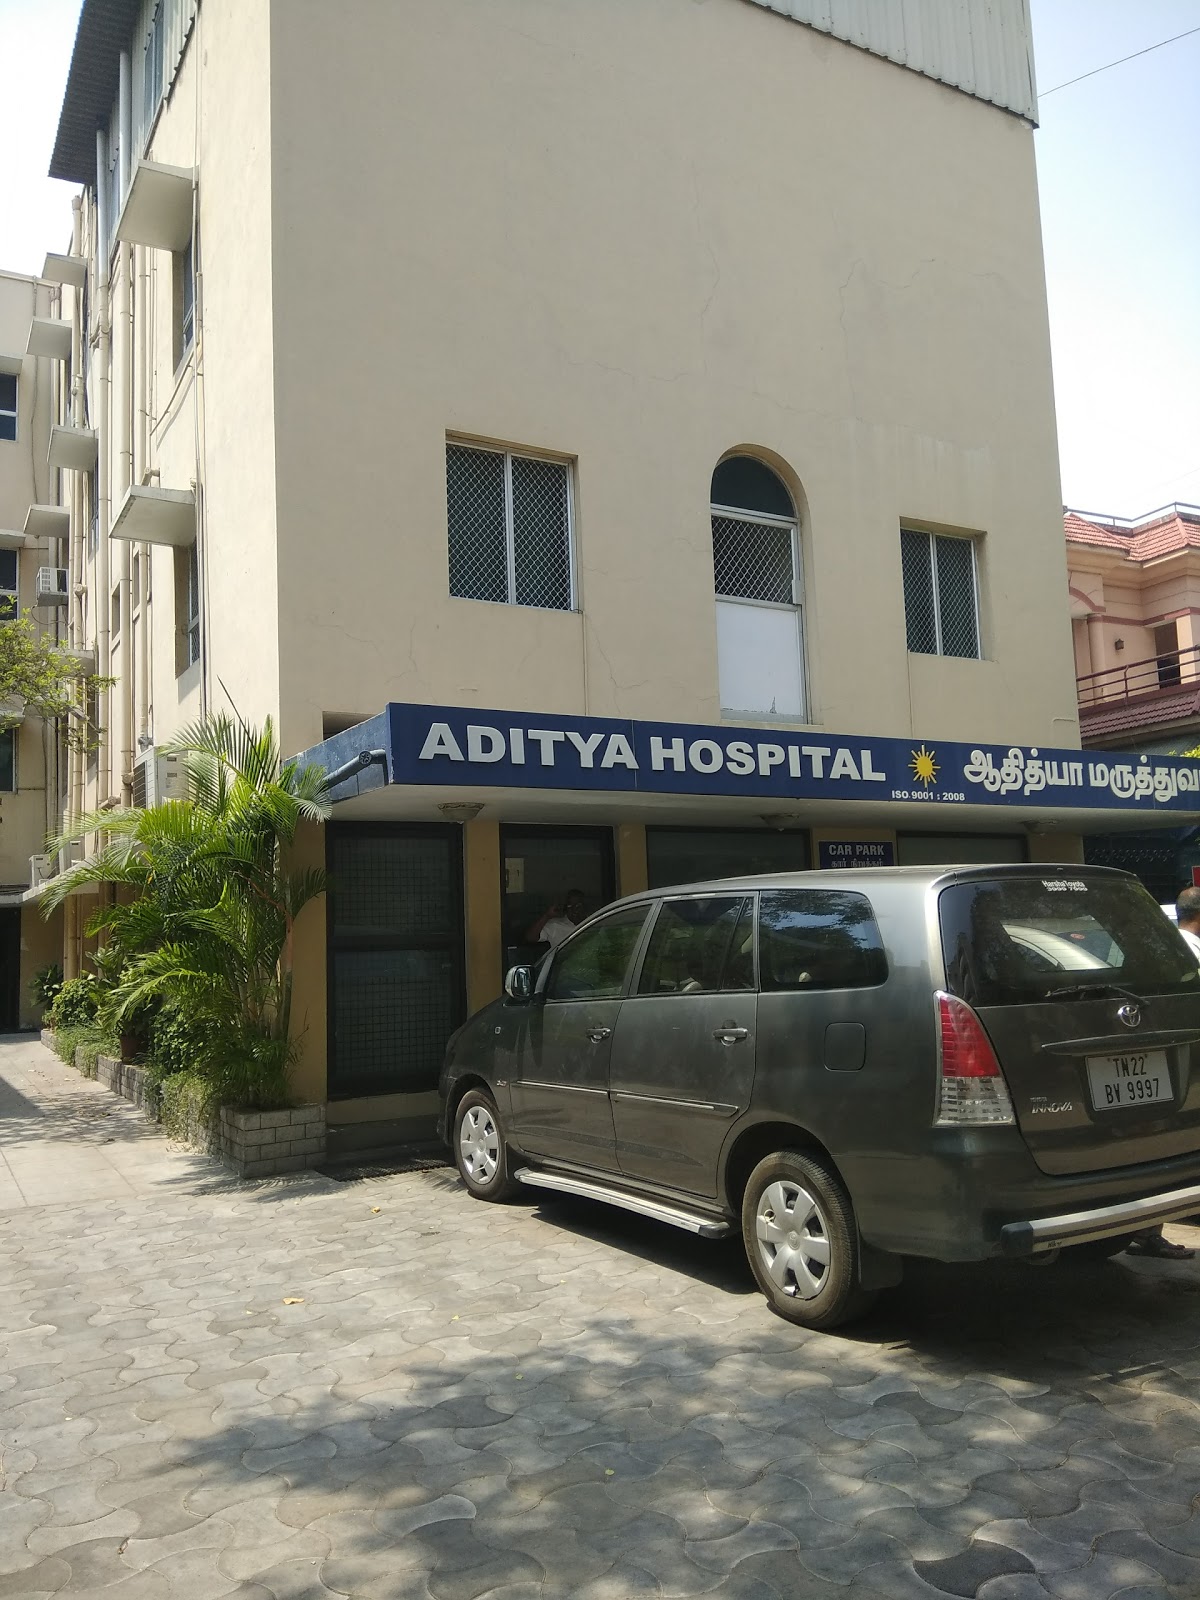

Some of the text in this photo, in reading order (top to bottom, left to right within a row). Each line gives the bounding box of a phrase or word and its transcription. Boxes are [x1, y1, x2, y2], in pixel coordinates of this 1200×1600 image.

[418, 722, 887, 781] ADITYA HOSPITAL
[963, 748, 1200, 803] ஆதித்யா மருத்துவ
[942, 792, 965, 801] 2008
[828, 844, 885, 856] CAR PARK
[1127, 1077, 1159, 1101] 9997
